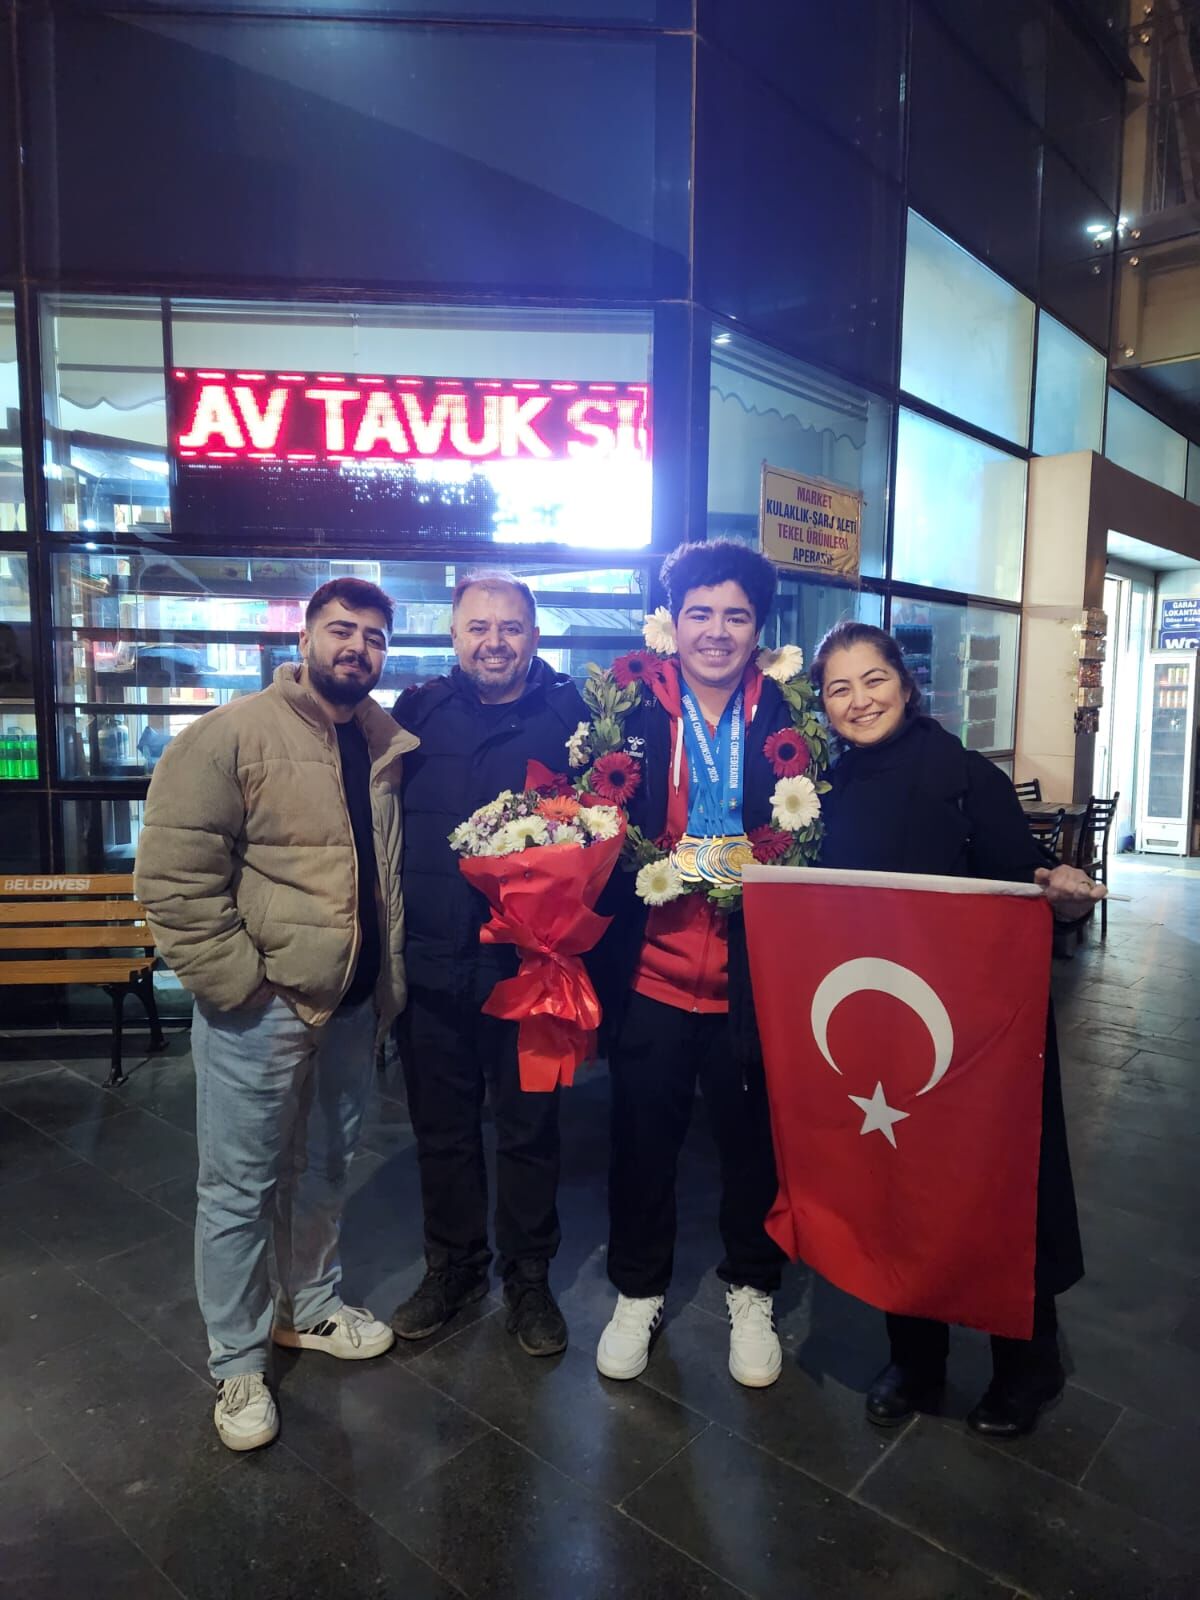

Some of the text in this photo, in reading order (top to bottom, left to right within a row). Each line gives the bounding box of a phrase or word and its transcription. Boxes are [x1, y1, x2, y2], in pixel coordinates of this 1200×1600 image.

[180, 385, 288, 448] AV
[304, 389, 552, 458] TAVUK
[796, 486, 833, 509] MARKET
[766, 499, 834, 529] KULAKLIK-ŞARJ
[778, 523, 849, 551] TEKEL ÜRÜNLERİ
[1172, 601, 1197, 609] GARAJ
[1165, 637, 1199, 649] WC
[681, 694, 697, 722] EUROPEAN
[692, 721, 714, 766] CHAMPIONSHIP
[729, 741, 740, 789] CONFEDERATION
